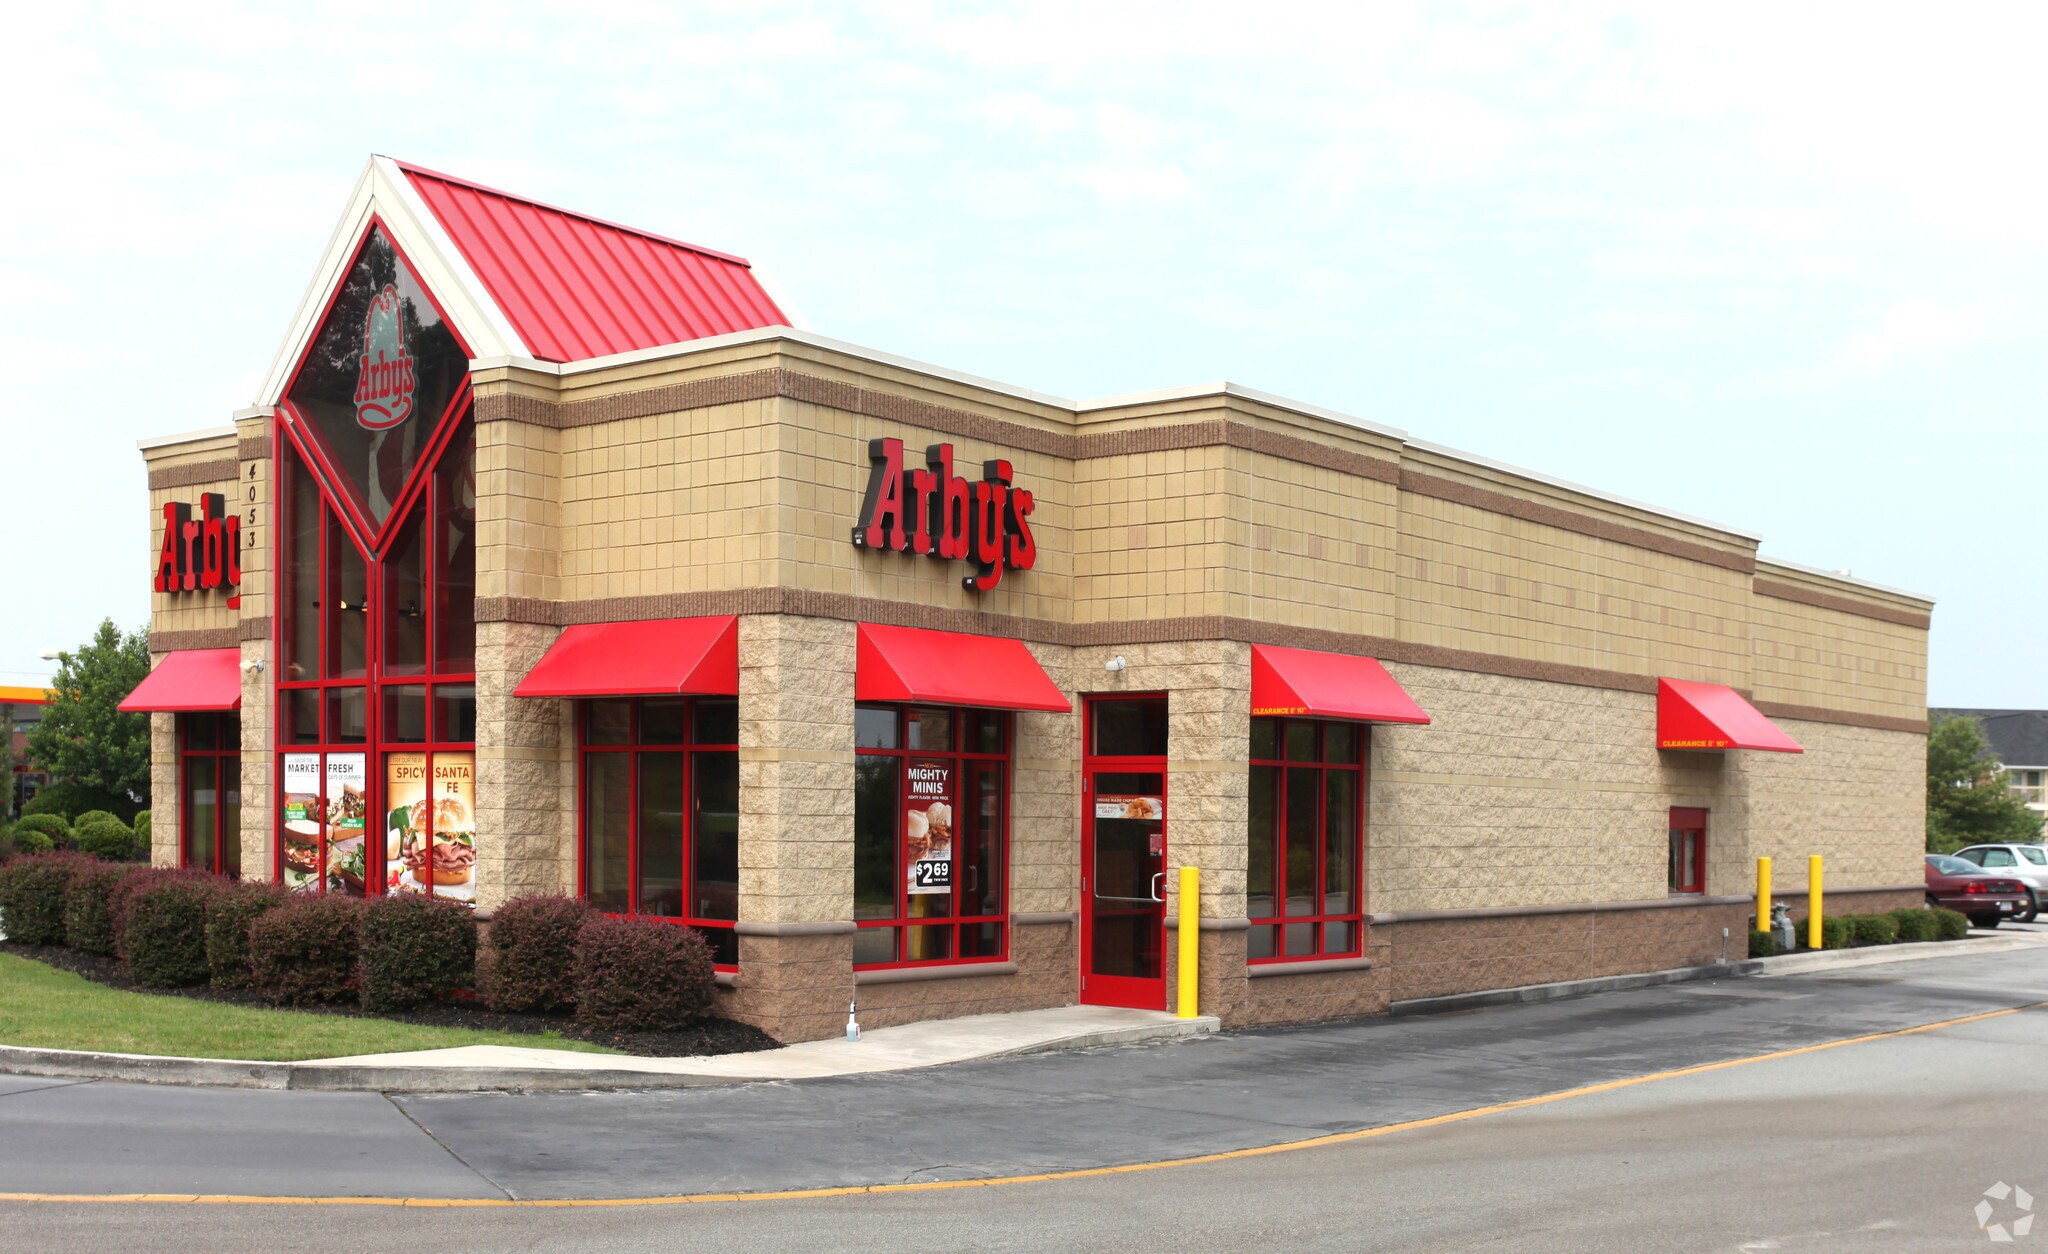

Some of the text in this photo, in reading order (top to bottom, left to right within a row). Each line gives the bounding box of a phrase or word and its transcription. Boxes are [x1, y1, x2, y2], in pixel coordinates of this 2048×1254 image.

[355, 349, 415, 408] Arby's
[864, 437, 1037, 591] Arby's
[1252, 707, 1288, 715] CLEARANCE
[288, 763, 354, 773] MARKET FRESH
[396, 767, 469, 779] SPICY SANTA
[908, 768, 948, 781] MIGHTY
[446, 782, 458, 793] FE
[913, 781, 943, 794] MINIS
